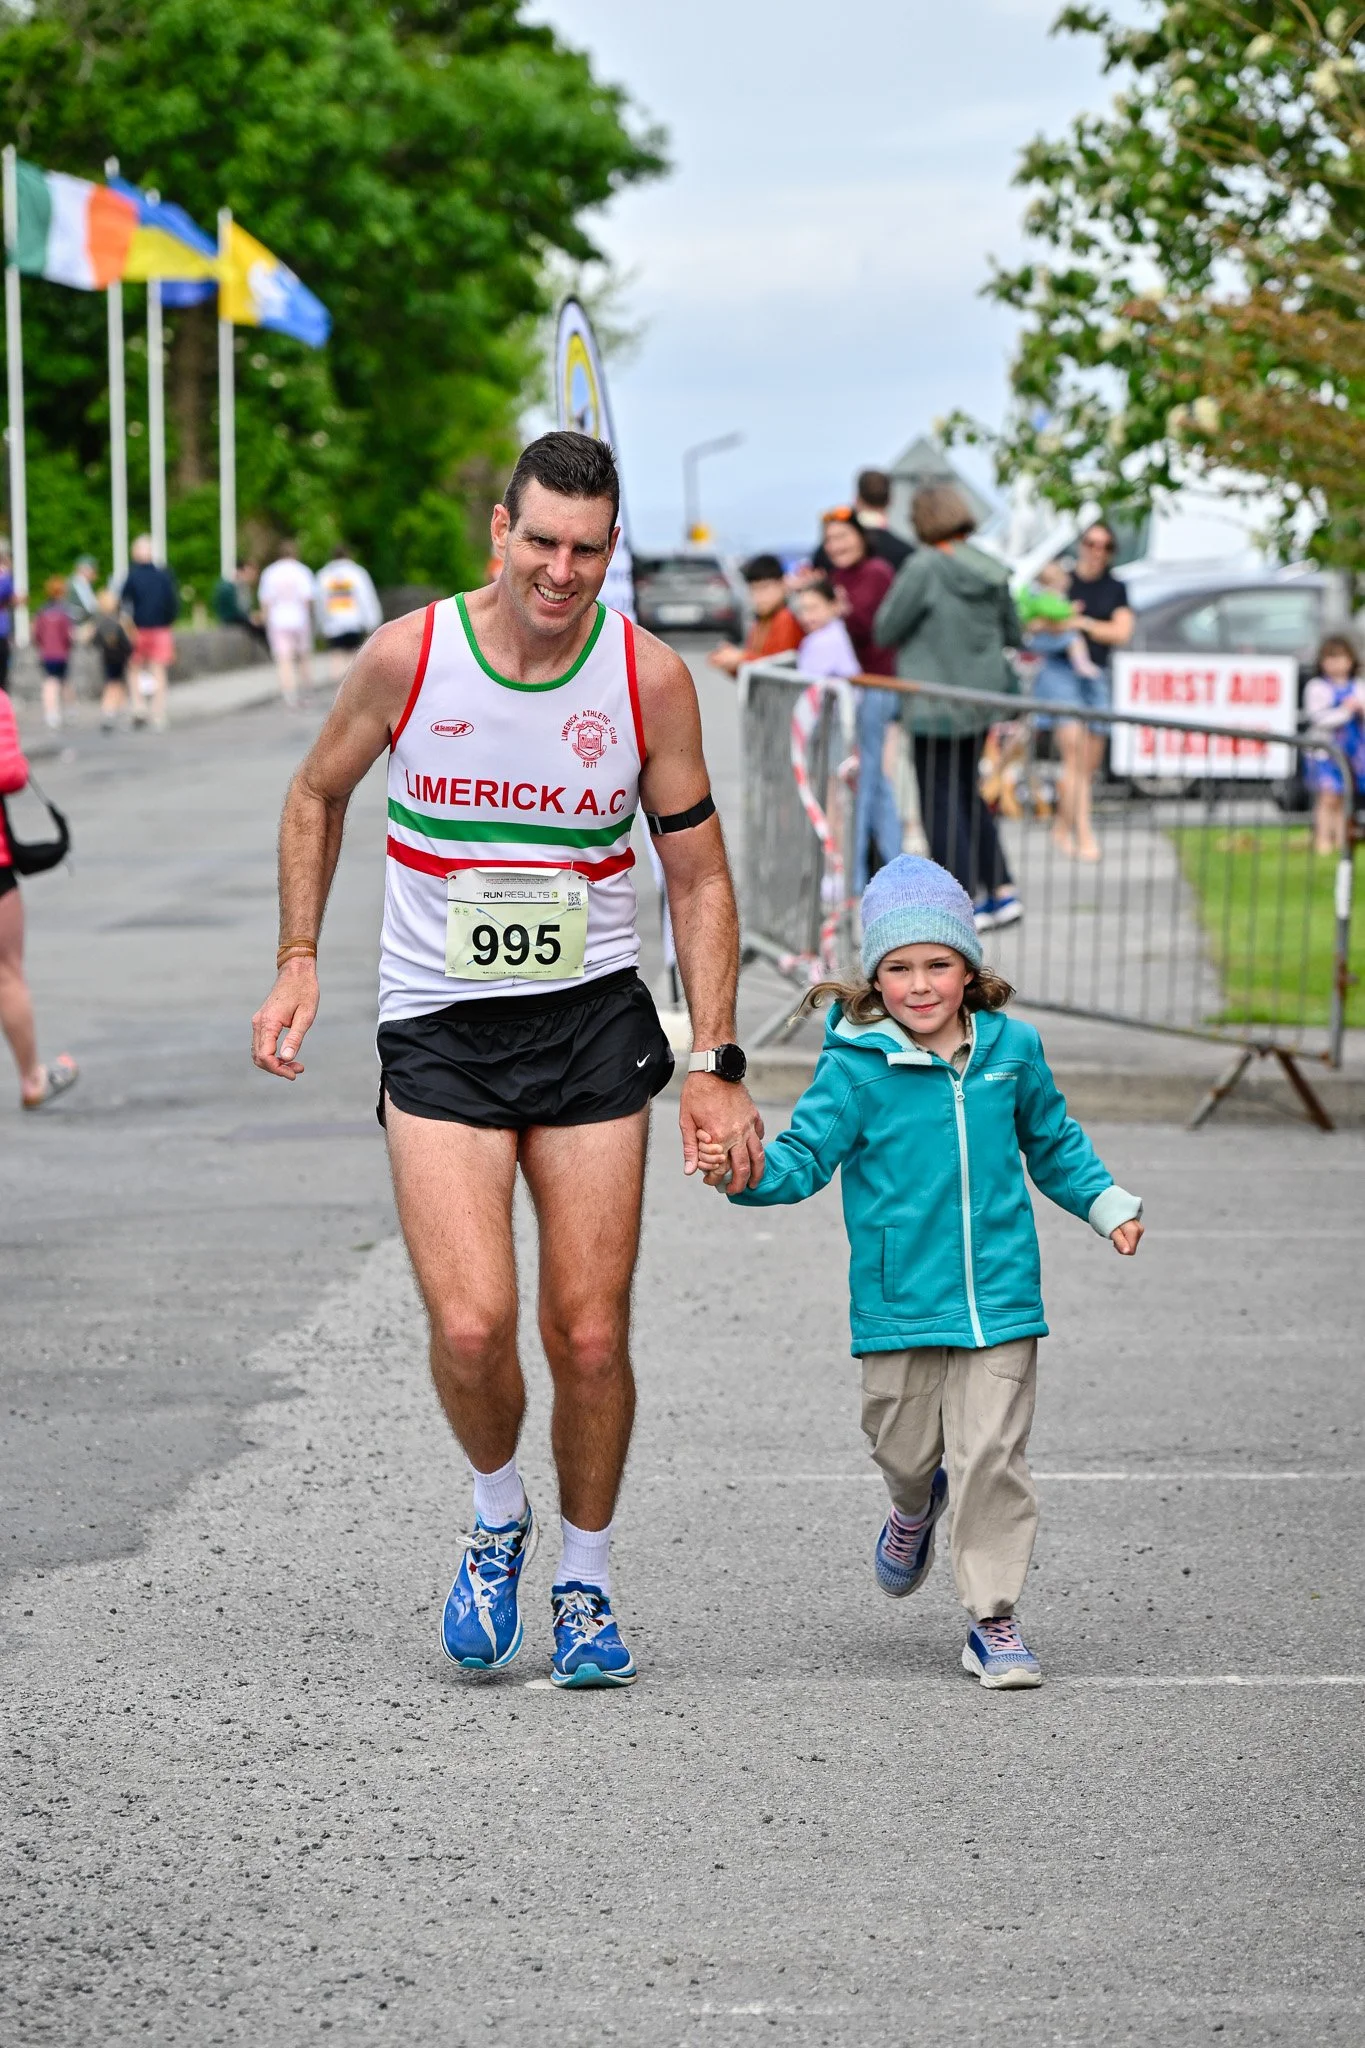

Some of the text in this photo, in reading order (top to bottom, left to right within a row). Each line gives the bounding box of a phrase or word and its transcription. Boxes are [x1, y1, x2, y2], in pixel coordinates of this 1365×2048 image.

[1130, 670, 1282, 706] FIRST AID
[561, 713, 579, 741] LIMERICK
[582, 710, 611, 725] ATHLETIC
[608, 727, 618, 744] CLUB
[582, 761, 597, 769] 1877
[406, 769, 626, 815] LIMERICK A.C.
[483, 891, 503, 899] RUN
[504, 891, 550, 899] RESULTS
[472, 924, 561, 966] 995
